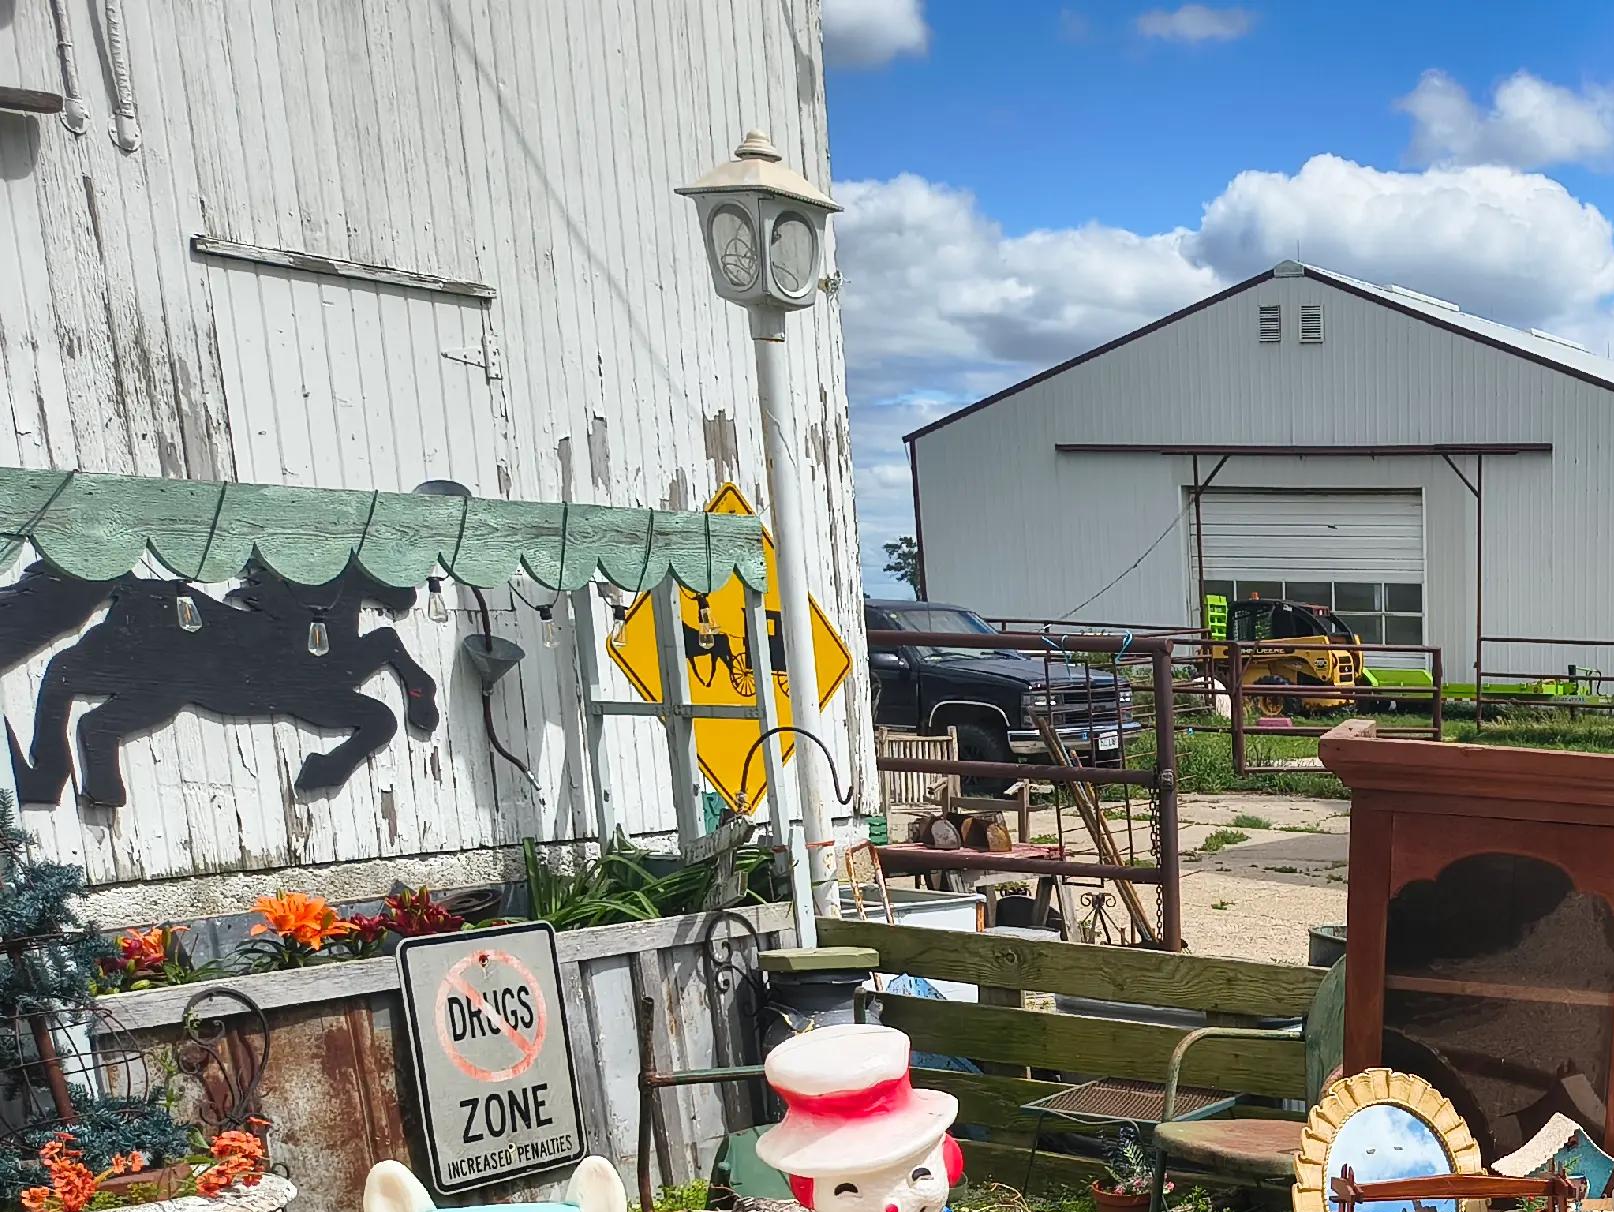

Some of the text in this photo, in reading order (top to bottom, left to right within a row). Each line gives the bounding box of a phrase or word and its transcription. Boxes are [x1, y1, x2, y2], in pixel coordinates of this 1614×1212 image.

[447, 984, 535, 1042] DRUGS
[459, 1083, 553, 1144] ZONE
[447, 1134, 573, 1180] INCREASED PENALTIES
